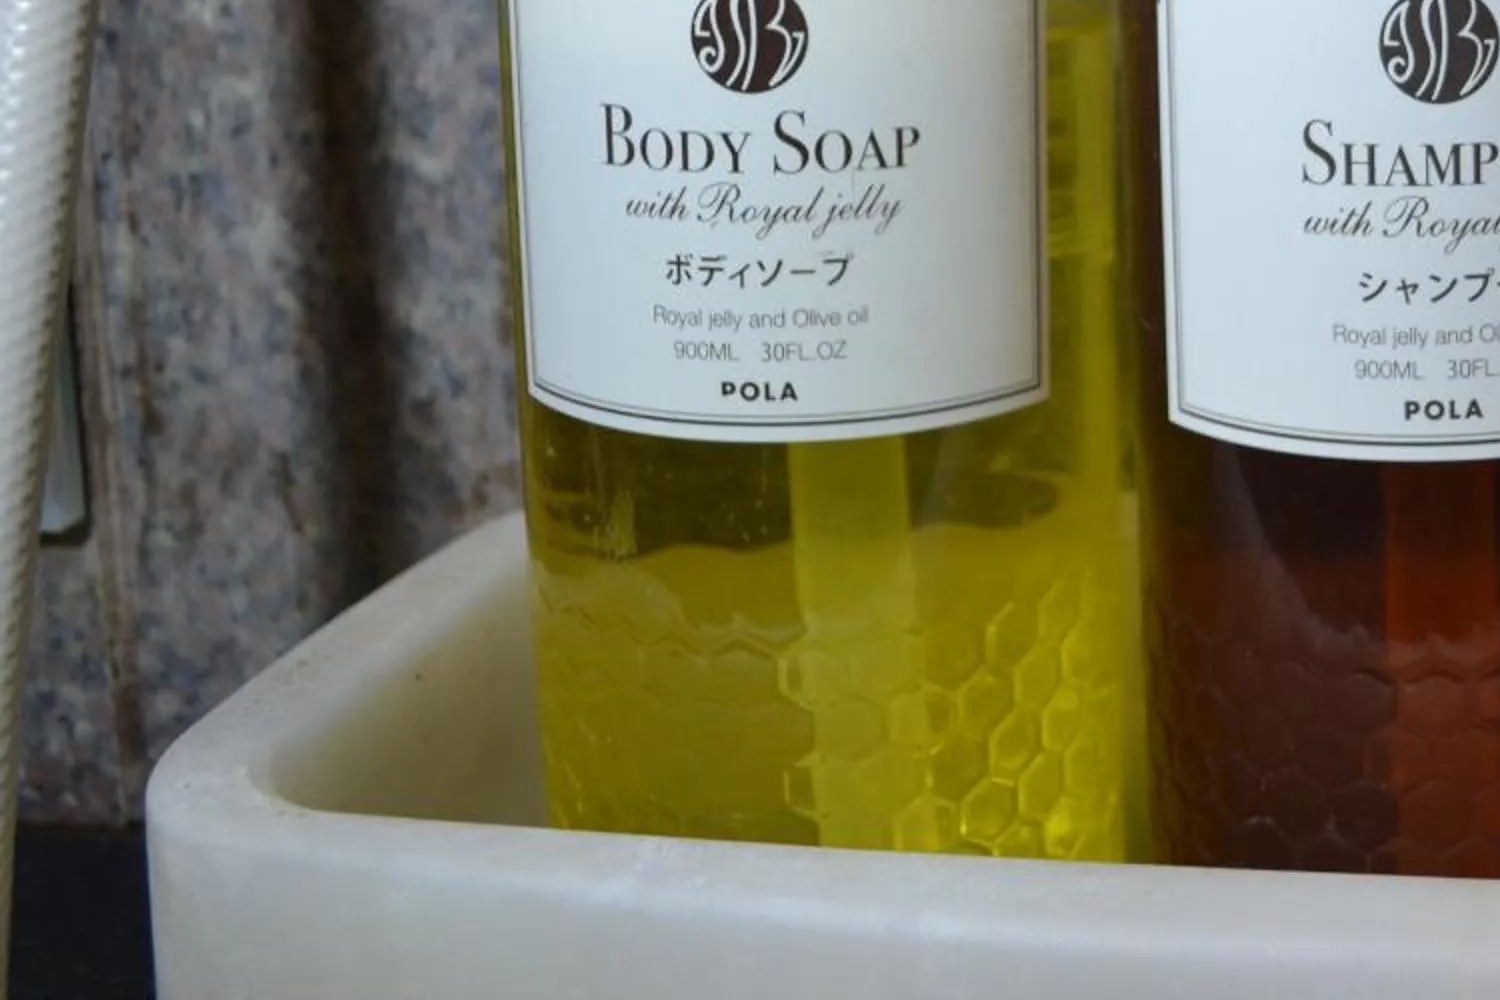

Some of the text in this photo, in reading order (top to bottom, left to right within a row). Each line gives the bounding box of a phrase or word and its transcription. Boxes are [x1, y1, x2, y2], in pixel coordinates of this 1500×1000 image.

[600, 103, 920, 175] BODY SOAP
[626, 183, 903, 240] with Royal jelly
[1303, 199, 1373, 237] with
[653, 304, 868, 332] Royal jelly and Olive oil
[1332, 324, 1386, 348] Royal
[1391, 327, 1428, 349] jelly
[1435, 326, 1473, 345] and
[673, 341, 739, 361] 900ML
[1354, 359, 1423, 380] 900ML
[721, 381, 798, 401] POLA
[1404, 398, 1484, 420] POLA
